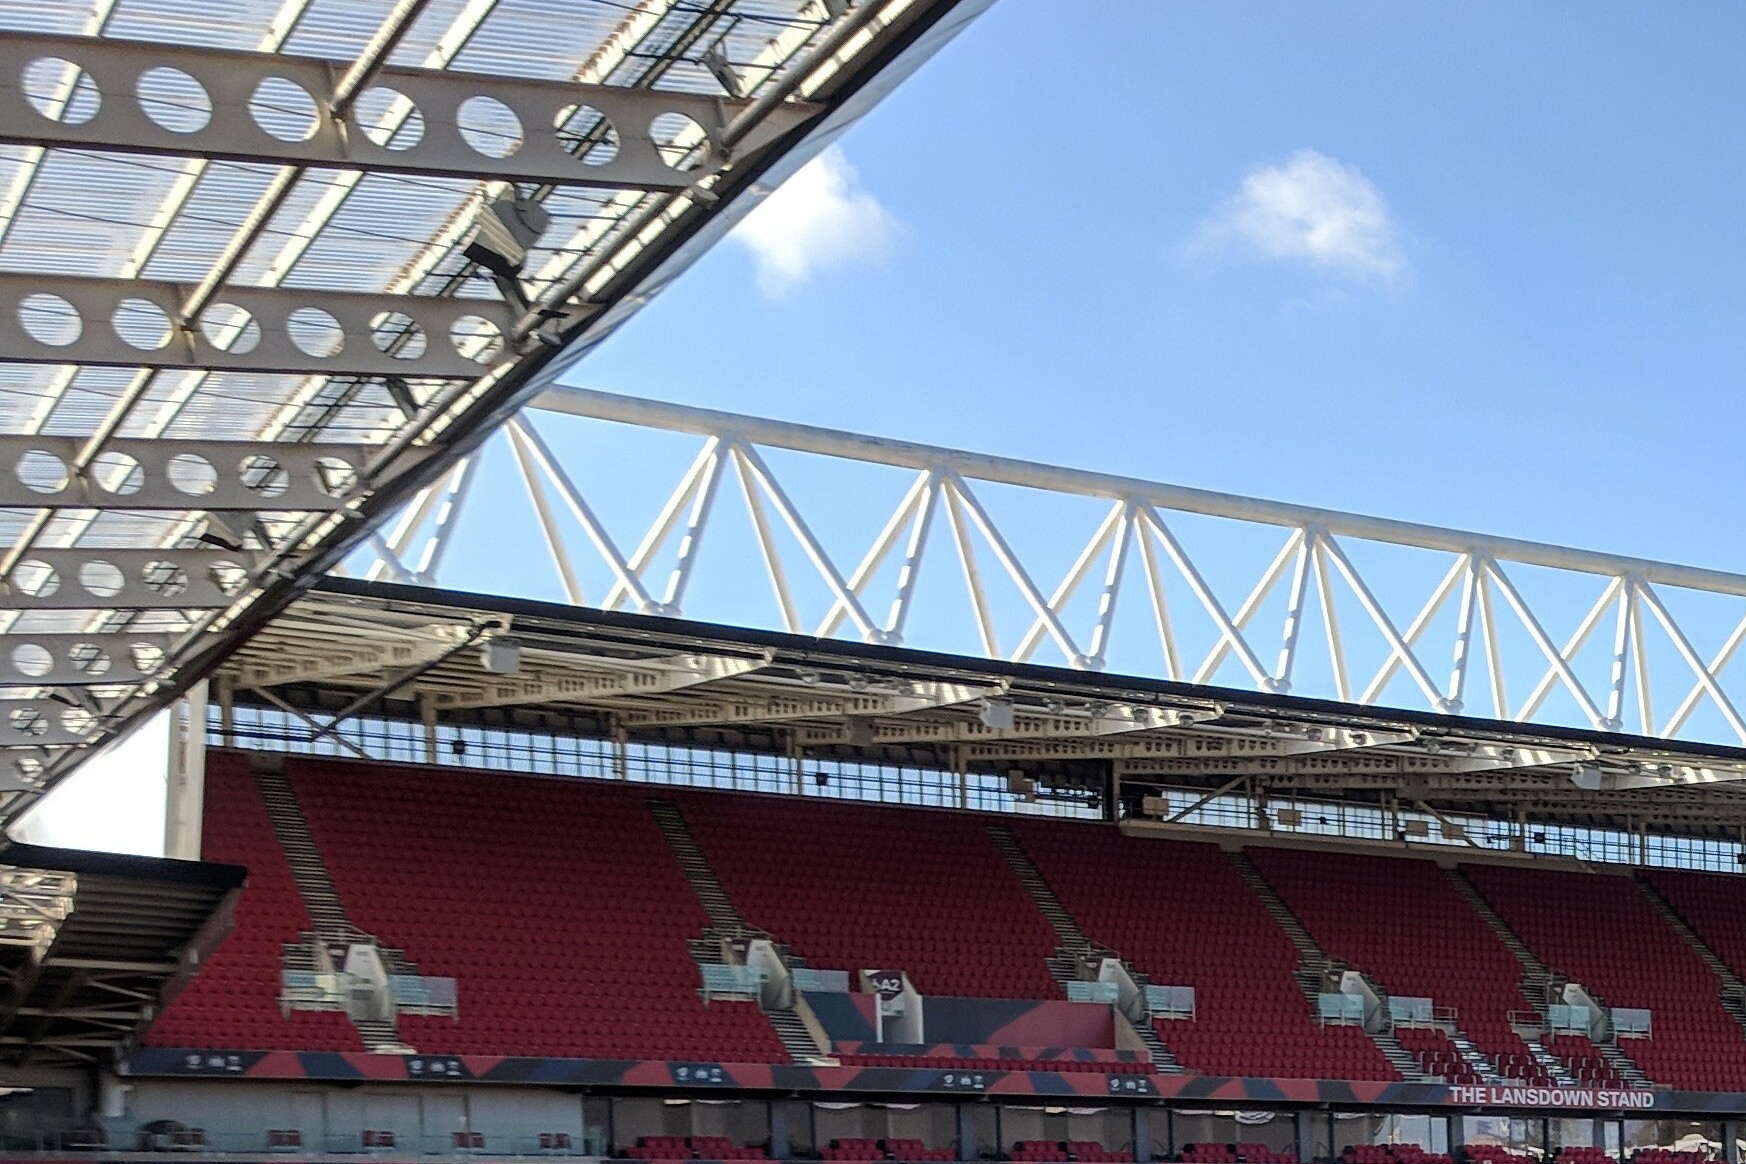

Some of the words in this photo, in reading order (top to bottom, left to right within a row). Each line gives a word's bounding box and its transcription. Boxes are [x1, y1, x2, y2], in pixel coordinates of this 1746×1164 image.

[1450, 1086, 1487, 1103] THE
[1490, 1087, 1593, 1107] LANSDOWN
[1596, 1091, 1655, 1109] STAND
